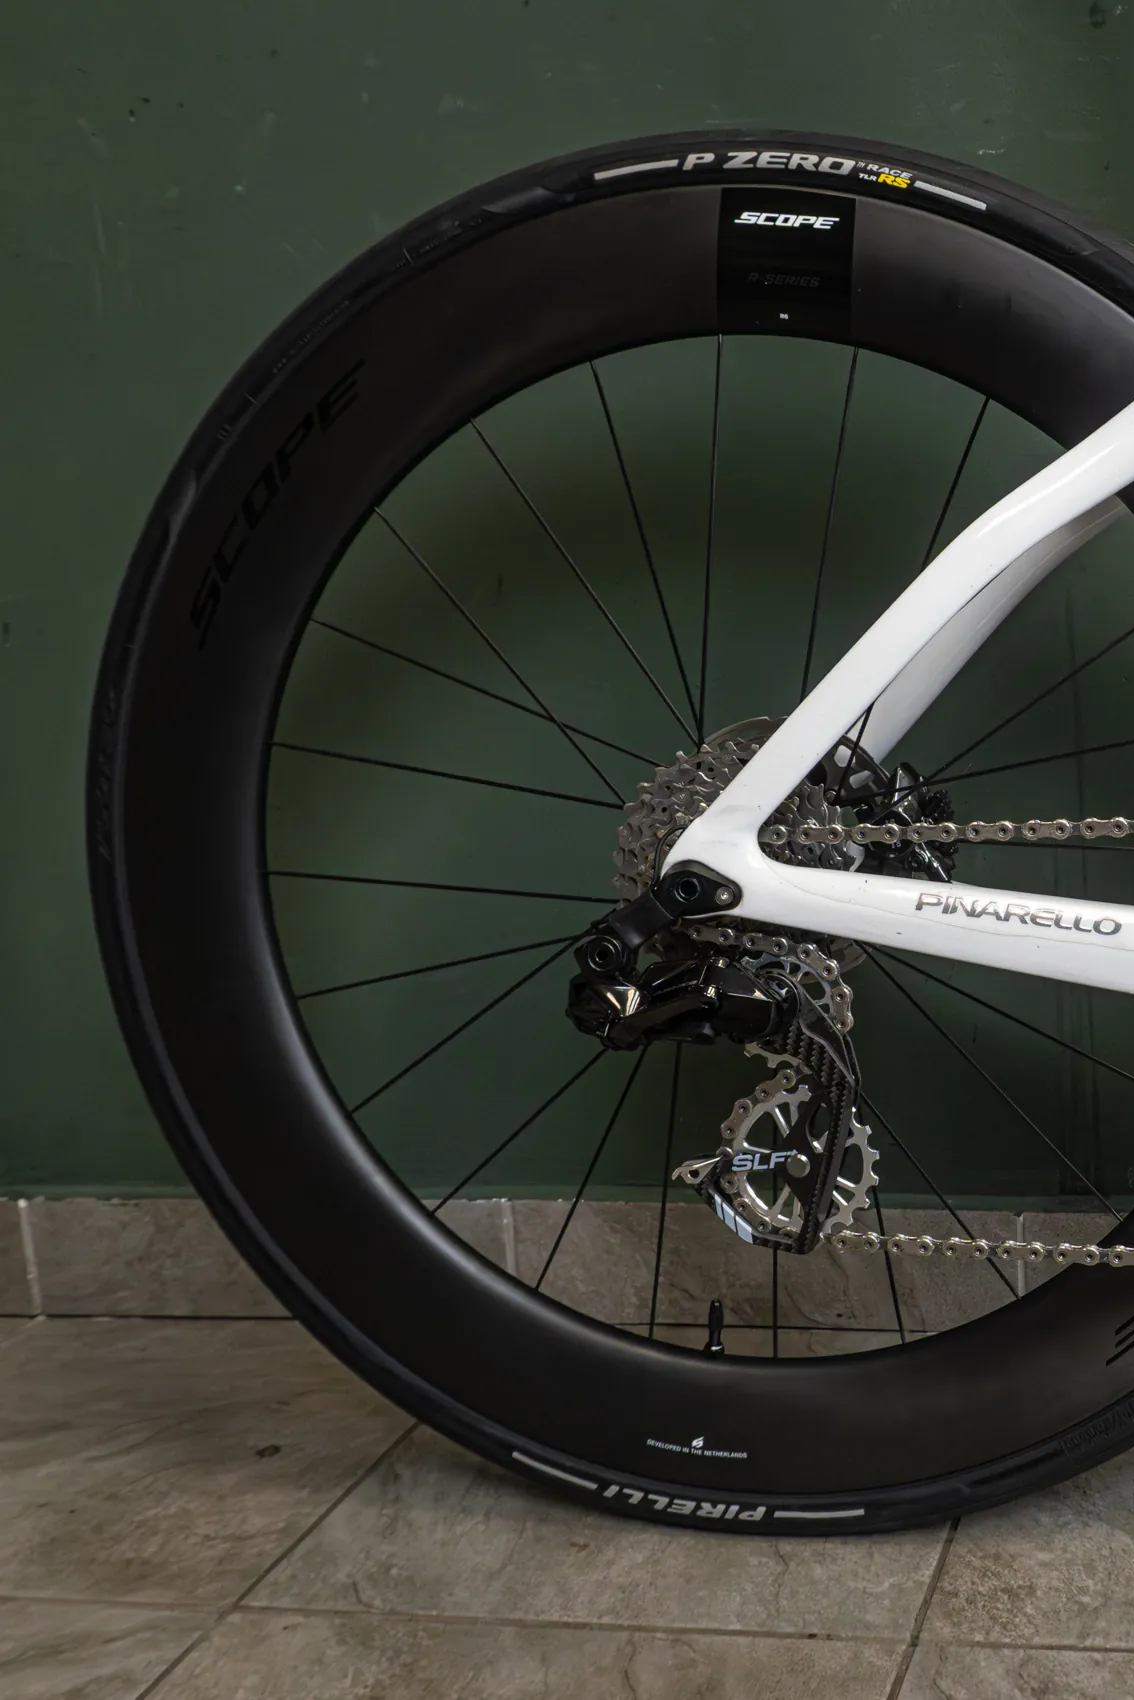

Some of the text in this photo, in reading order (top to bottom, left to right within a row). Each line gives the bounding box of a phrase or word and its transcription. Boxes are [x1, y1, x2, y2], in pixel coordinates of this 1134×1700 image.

[682, 152, 716, 171] P
[722, 151, 855, 175] ZERO
[866, 163, 913, 179] RACE
[859, 172, 911, 188] TLR RS
[733, 211, 841, 230] SCOPE
[190, 357, 366, 651] SCOPE
[914, 892, 1123, 936] PINARELLO
[646, 1438, 681, 1452] DEVELOPED
[691, 1448, 702, 1456] THE
[703, 1449, 748, 1459] NETHERLANDS
[602, 1484, 767, 1521] PIRELLI
